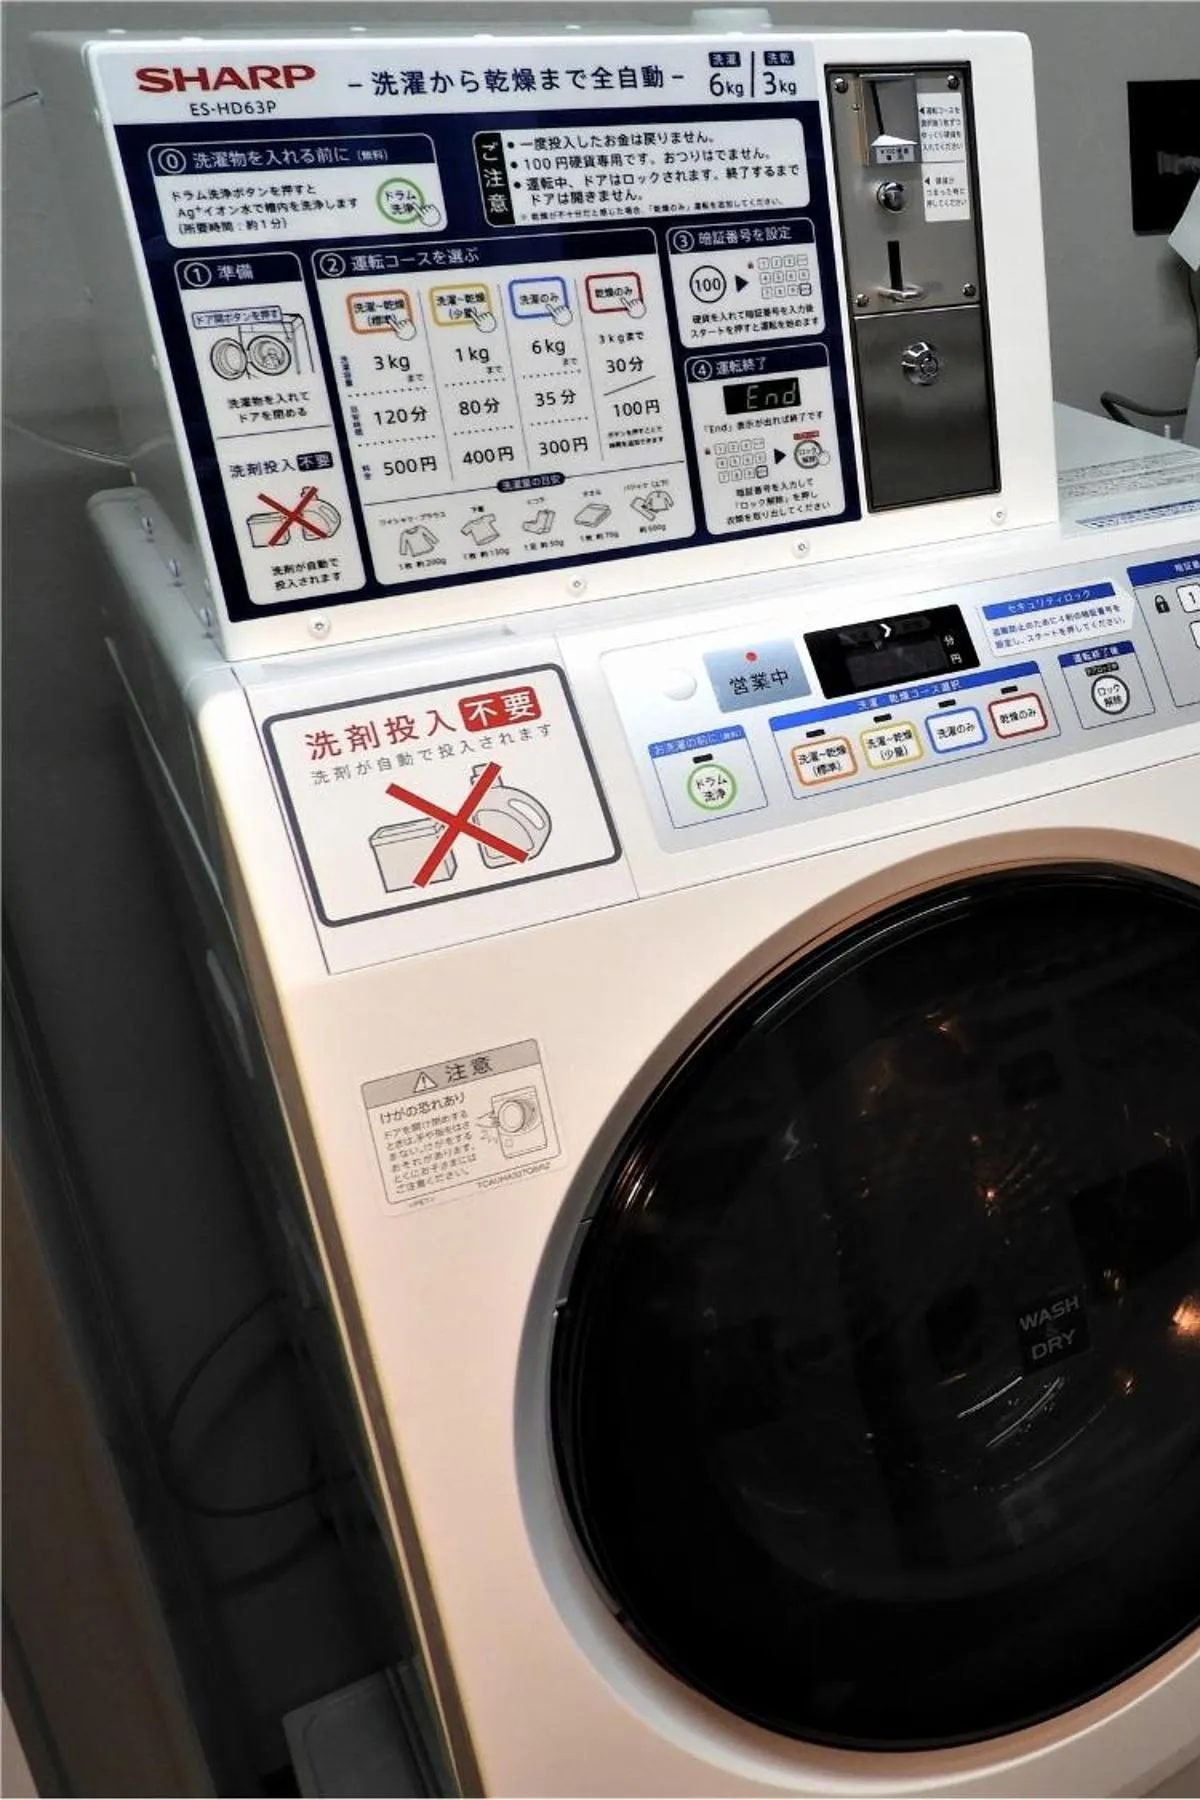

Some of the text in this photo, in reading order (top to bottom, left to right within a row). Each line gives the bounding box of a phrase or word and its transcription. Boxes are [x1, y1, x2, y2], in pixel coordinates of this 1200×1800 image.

[135, 65, 316, 93] SHARP
[190, 101, 277, 116] ES-HD63P
[482, 141, 508, 214] ご注意
[385, 190, 416, 202] ドラム
[351, 247, 479, 271] 運転コースを選ぶ
[217, 263, 254, 280] 準備
[695, 278, 721, 292] 100
[606, 356, 643, 373] 30分
[716, 356, 767, 376] 運転終了
[535, 389, 577, 407] 35分
[747, 382, 796, 410] End
[374, 405, 428, 425] 120分
[459, 398, 500, 416] 80分
[614, 399, 660, 418] 100円
[463, 445, 515, 466] 400円
[539, 436, 589, 456] 300円
[383, 455, 437, 476] 500円
[1188, 591, 1196, 605] 1
[729, 668, 789, 696] 営業中
[1098, 683, 1121, 696] ロック
[305, 690, 539, 761] 洗剤投入 不要
[999, 708, 1036, 726] 乾燥のみ
[936, 723, 975, 740] 洗濯のみ
[310, 723, 552, 786] 洗剤が自動で投入されます
[696, 774, 728, 789] ドラム
[445, 1056, 493, 1083] 注意
[1019, 1295, 1080, 1332] WASH
[1031, 1328, 1076, 1361] DRY
